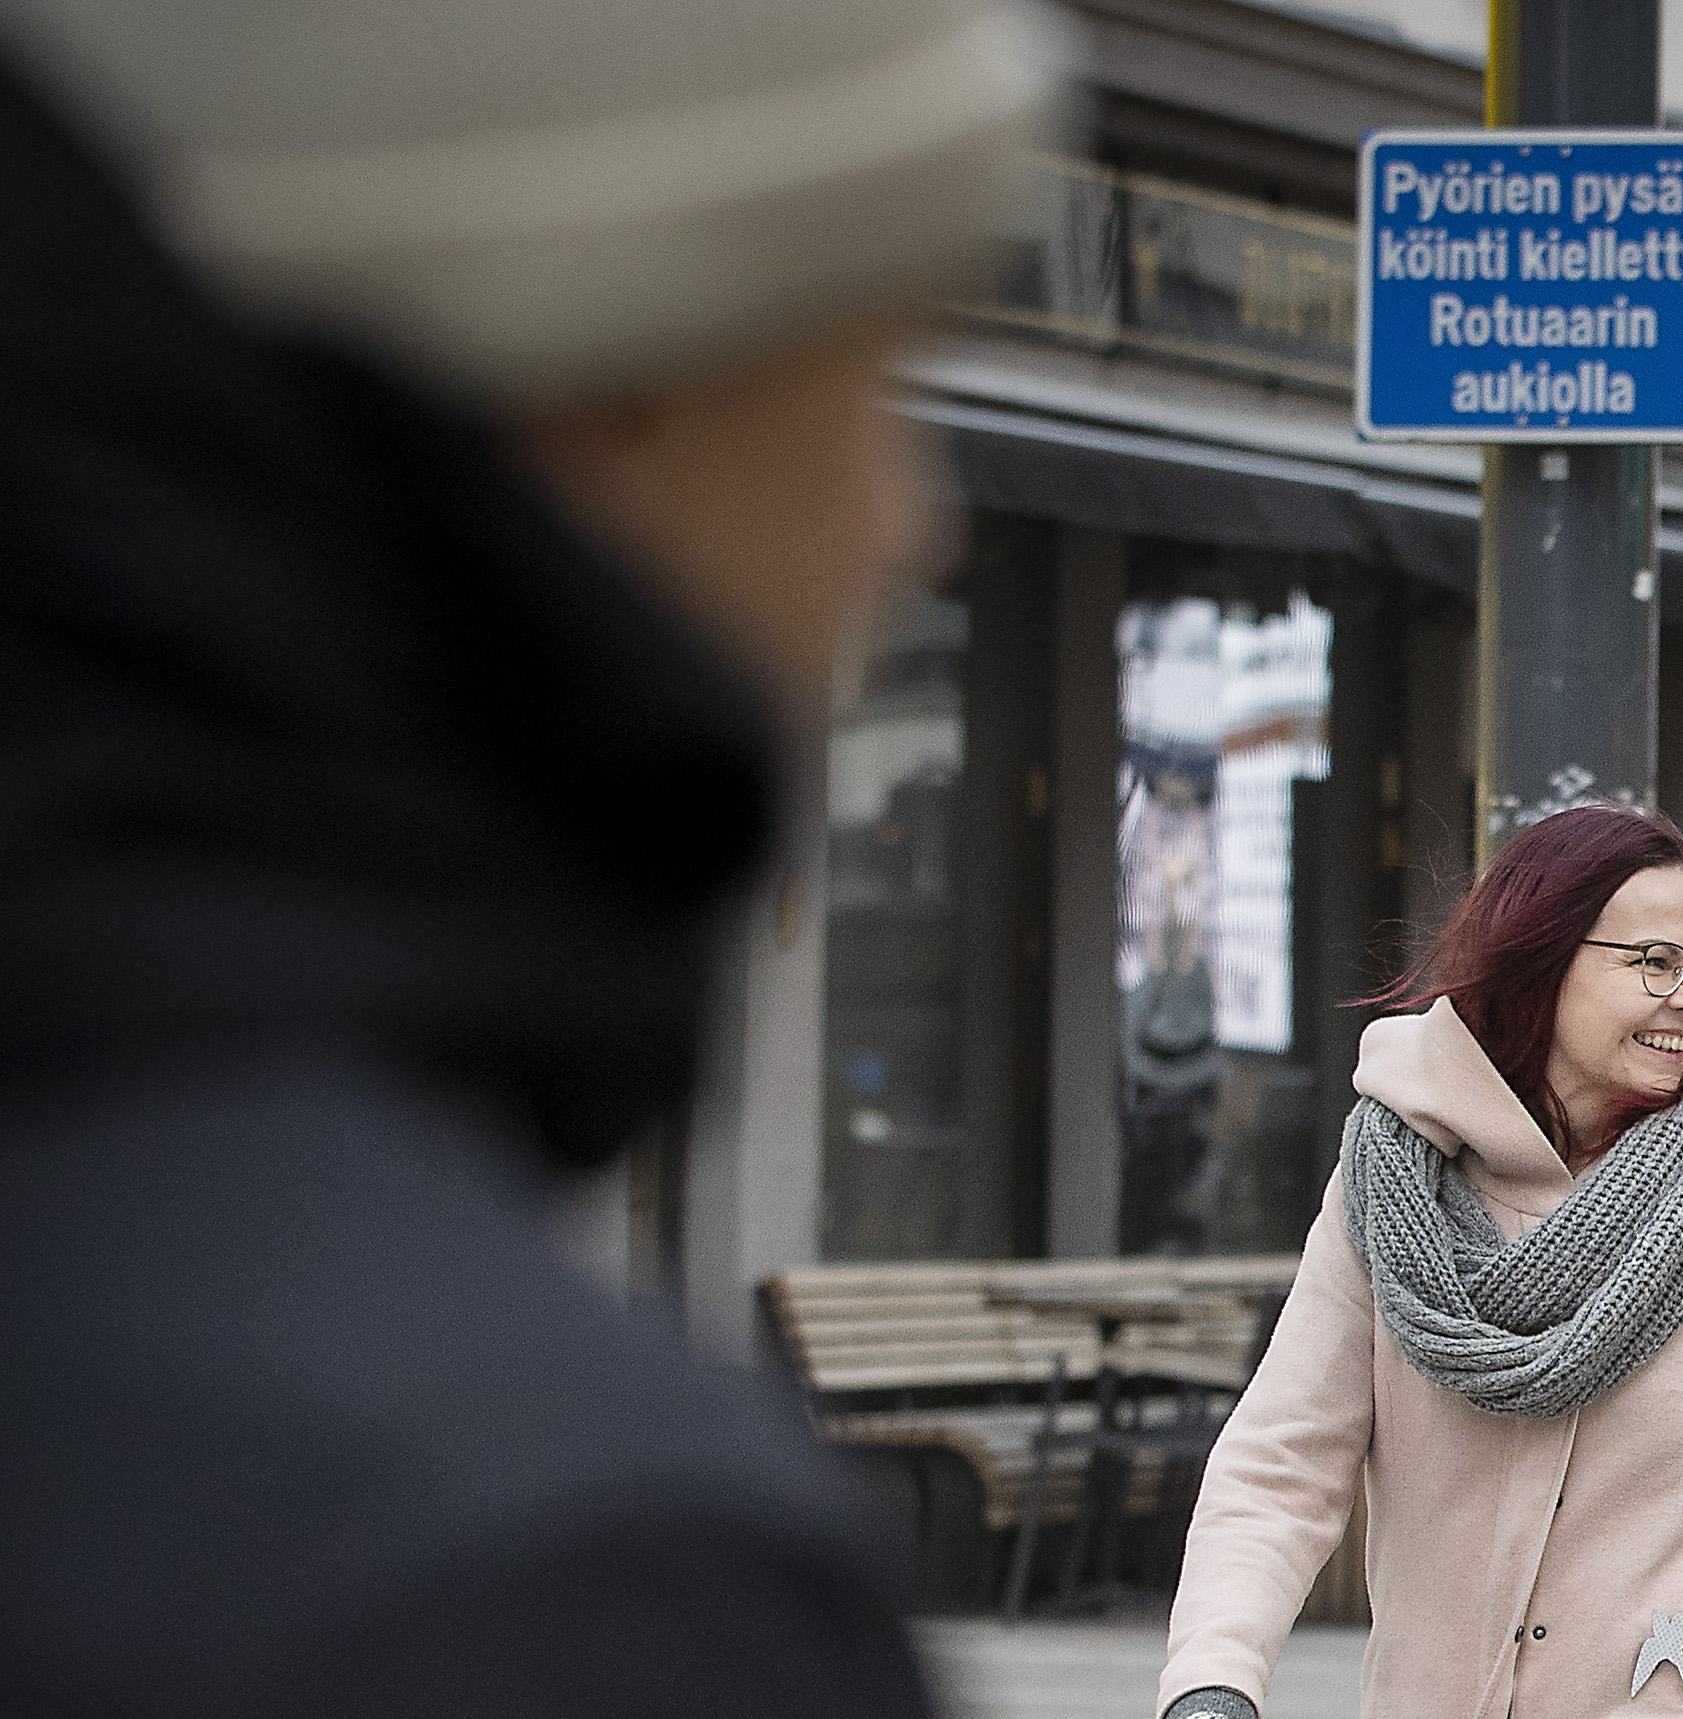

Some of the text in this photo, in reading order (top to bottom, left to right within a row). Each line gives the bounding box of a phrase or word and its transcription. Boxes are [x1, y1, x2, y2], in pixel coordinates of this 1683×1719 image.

[1383, 160, 1561, 222] Pyörien
[1379, 228, 1508, 281] köinti
[1430, 293, 1658, 348] Rotuaarin
[1451, 360, 1636, 414] aukiolla
